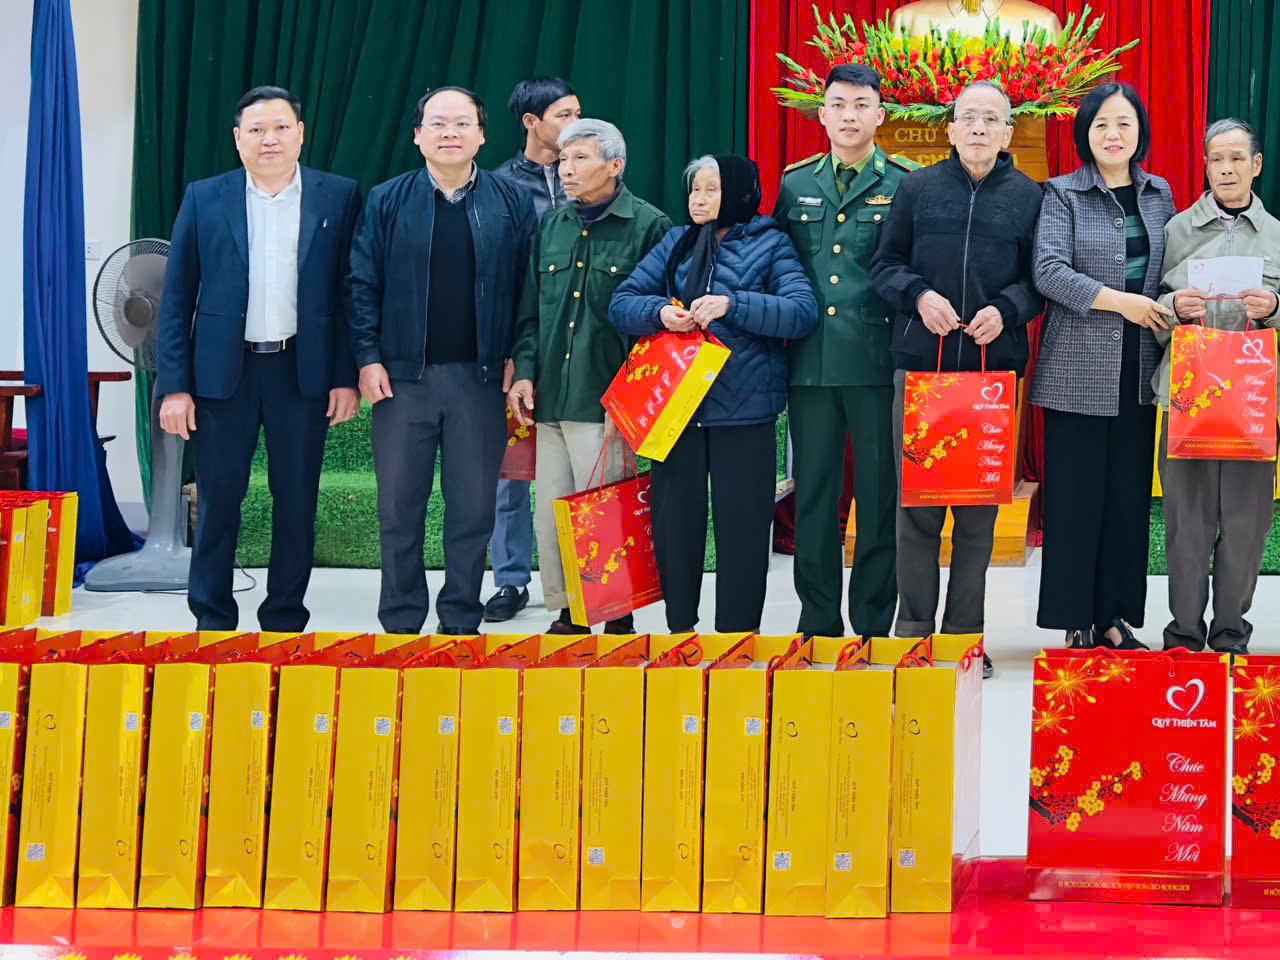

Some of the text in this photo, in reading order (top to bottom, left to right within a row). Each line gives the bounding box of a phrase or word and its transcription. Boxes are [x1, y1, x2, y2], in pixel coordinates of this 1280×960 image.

[1152, 717, 1216, 728] QUỸ THIỆN TÂM
